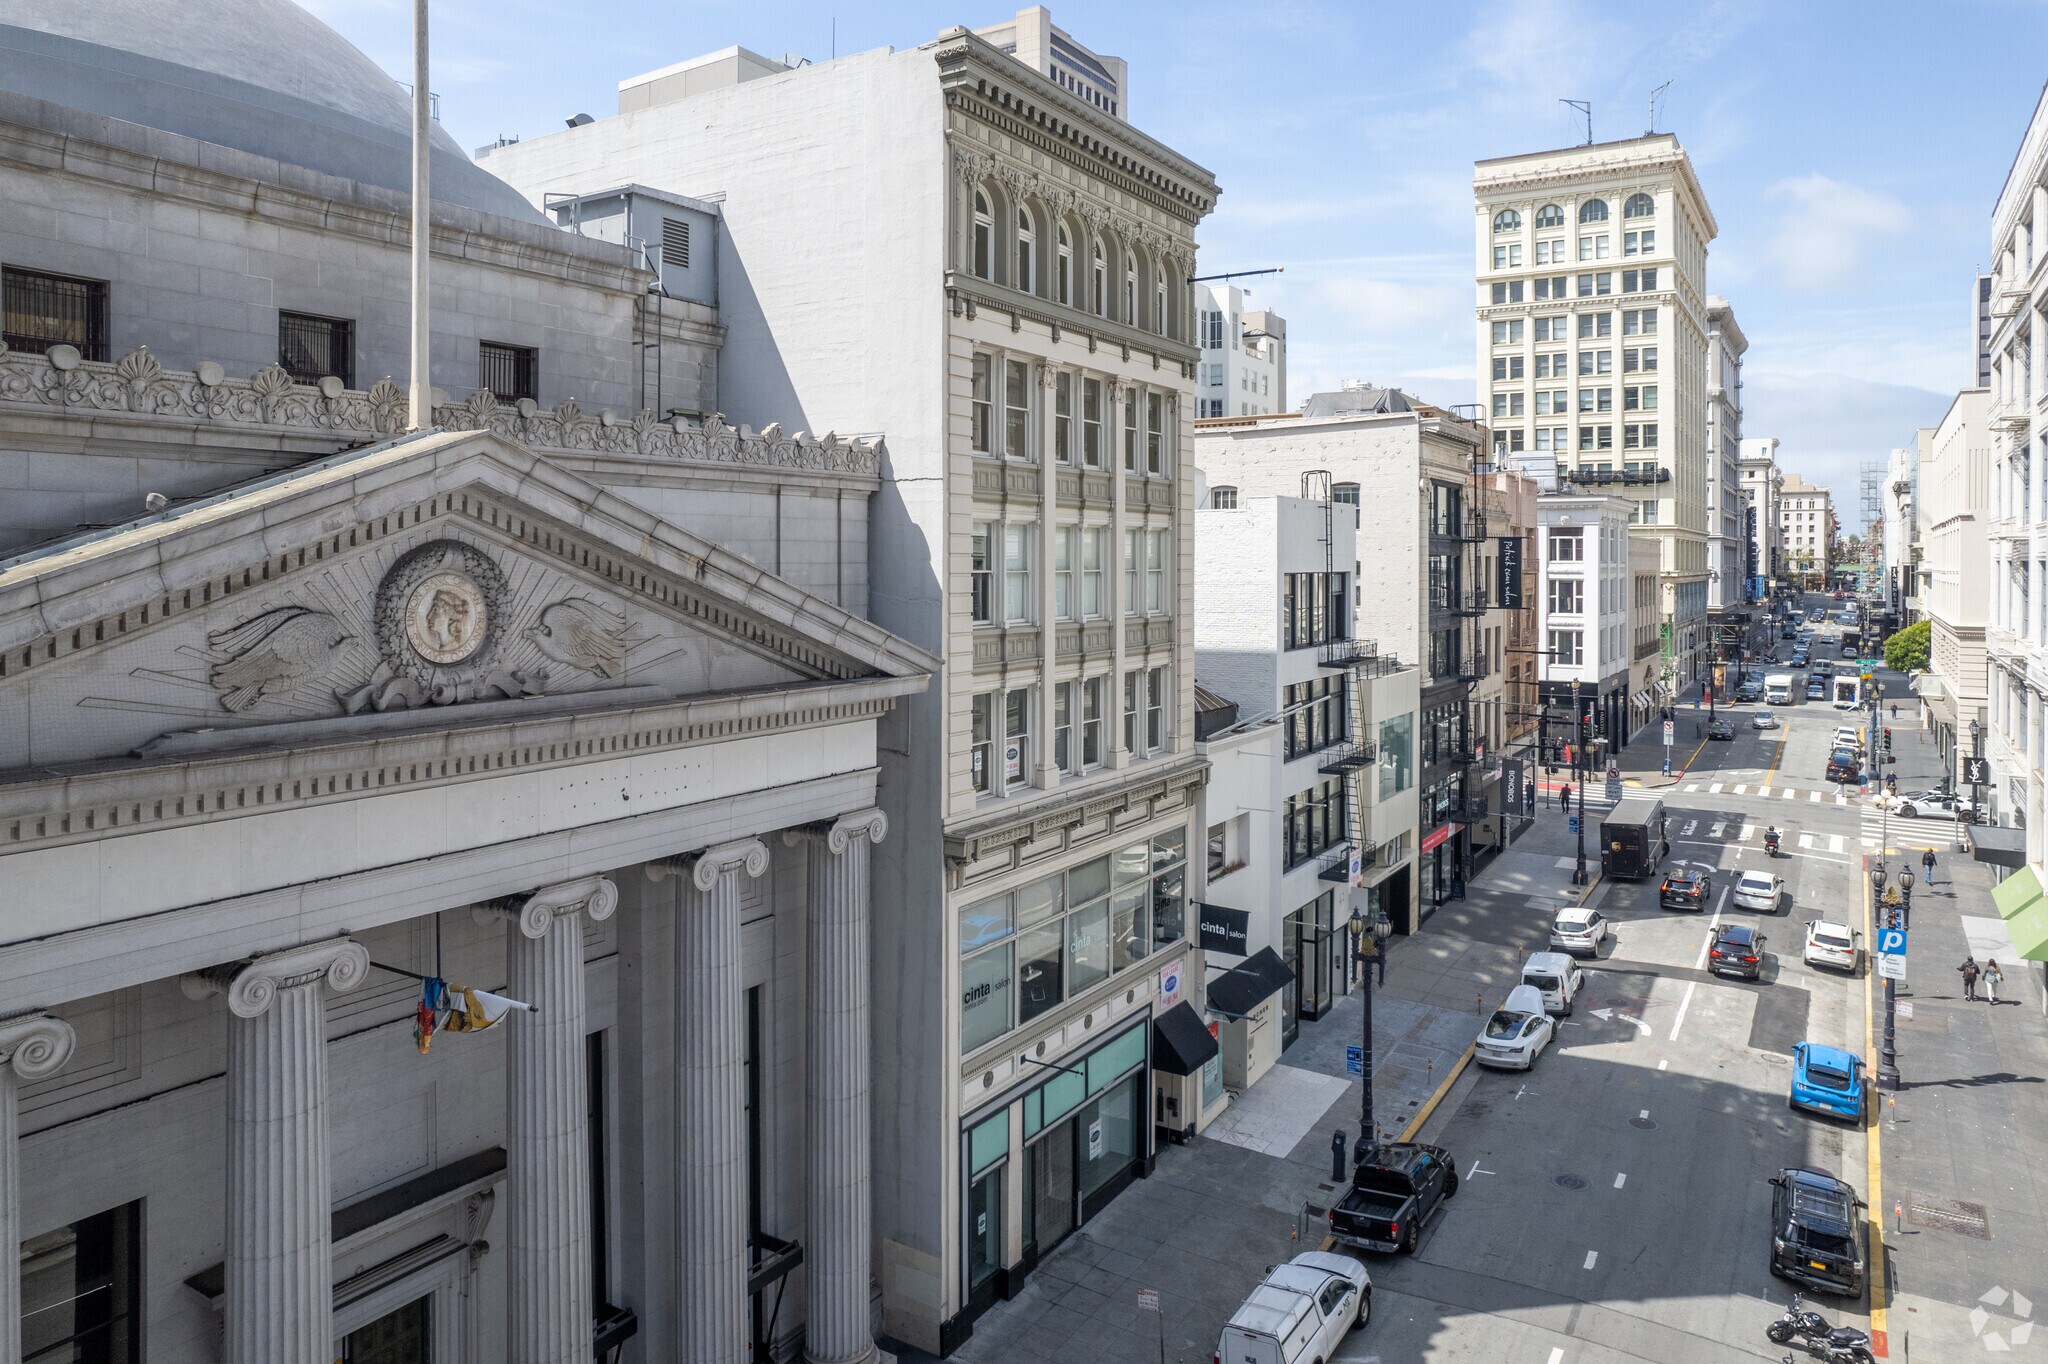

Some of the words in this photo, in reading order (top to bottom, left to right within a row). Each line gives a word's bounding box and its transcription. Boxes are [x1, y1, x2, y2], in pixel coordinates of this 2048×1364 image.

[1503, 541, 1516, 566] Patrick
[407, 591, 423, 627] UNION
[1507, 770, 1516, 803] BONOBOS
[1201, 922, 1225, 935] cinta
[1229, 930, 1246, 939] salon
[1882, 931, 1903, 952] P
[1070, 935, 1091, 953] cinta
[964, 983, 991, 1004] cinta
[995, 978, 1011, 991] salon
